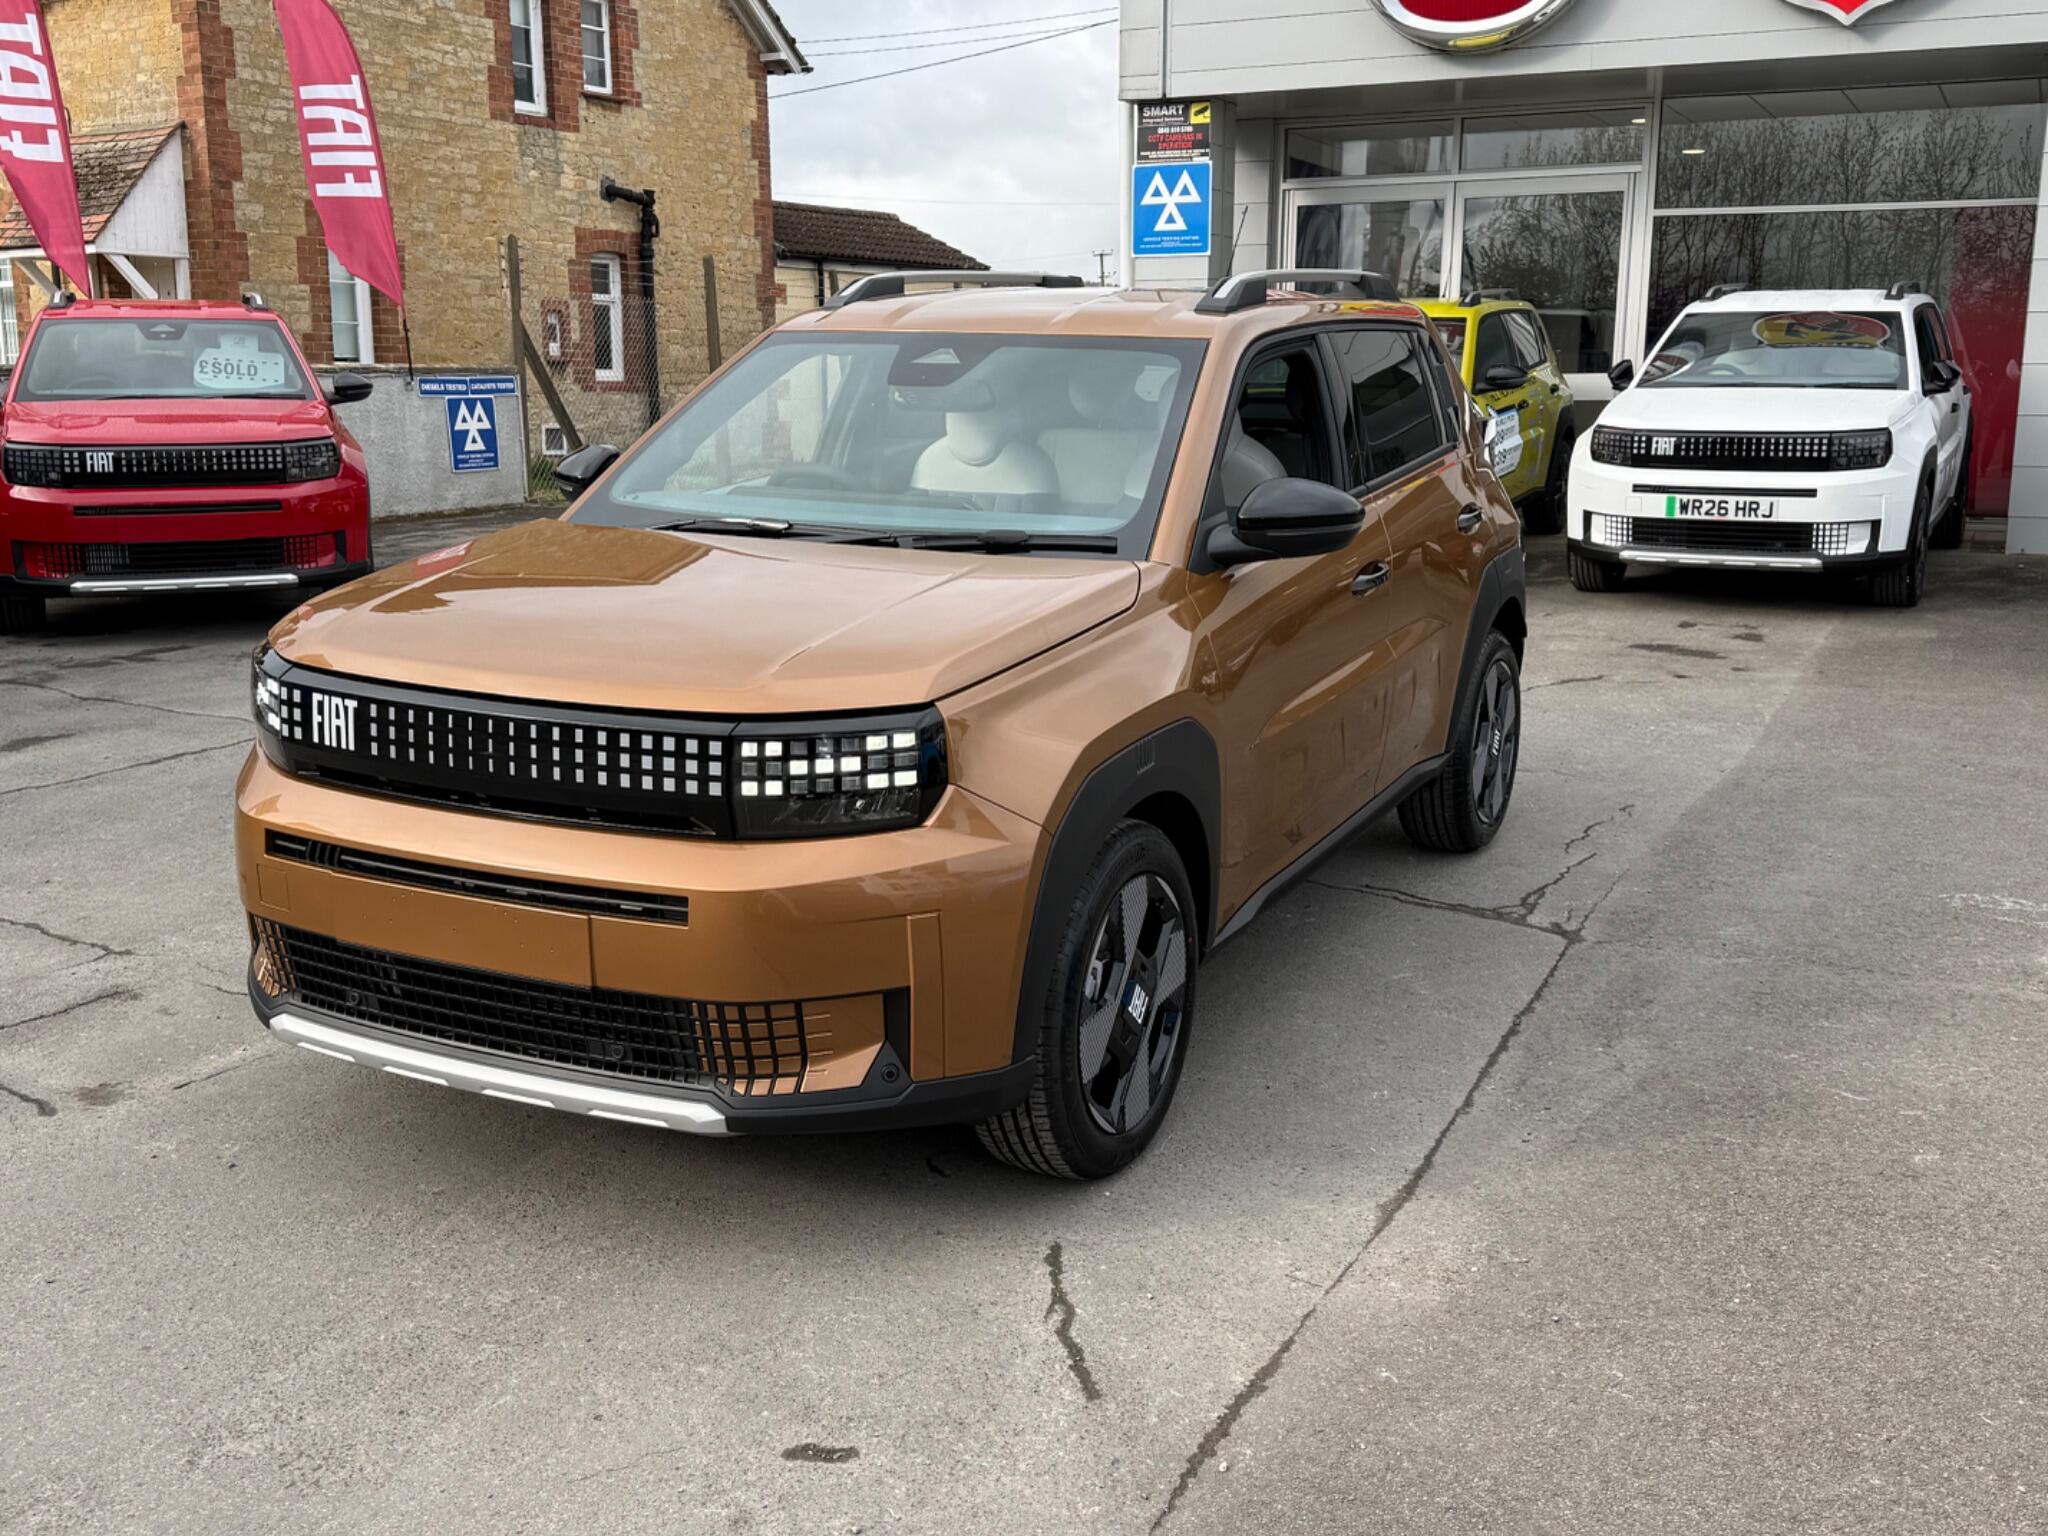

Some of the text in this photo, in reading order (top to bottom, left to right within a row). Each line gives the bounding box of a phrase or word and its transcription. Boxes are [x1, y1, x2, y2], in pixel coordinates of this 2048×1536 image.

[1142, 105, 1185, 117] SMART
[1651, 437, 1677, 456] FIAT
[86, 451, 114, 473] FIAT
[1679, 498, 1774, 518] WR26 HRJ
[312, 691, 358, 751] FIAT
